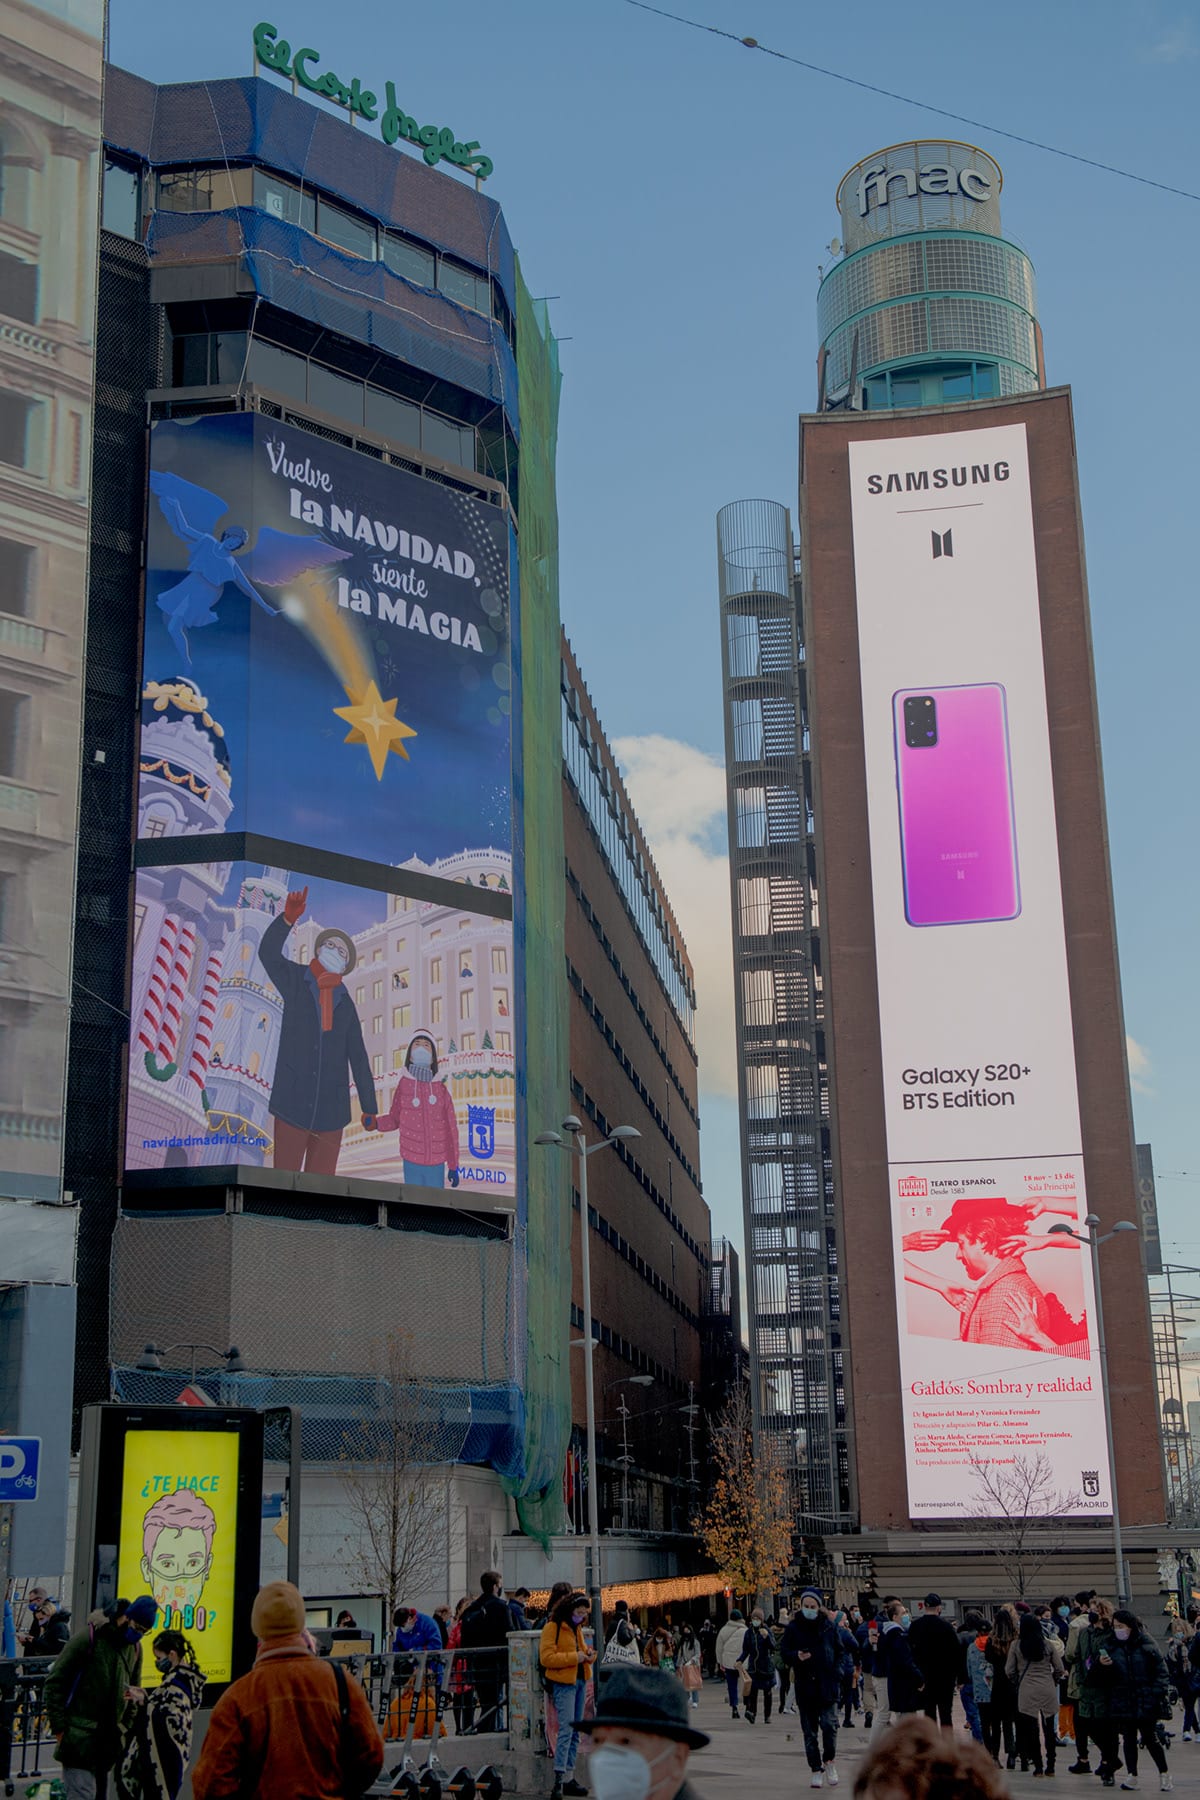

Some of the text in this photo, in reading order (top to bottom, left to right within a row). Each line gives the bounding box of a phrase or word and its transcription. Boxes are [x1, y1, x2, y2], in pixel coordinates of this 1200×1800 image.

[253, 22, 494, 178] El Corte Inglés
[856, 163, 992, 217] fnac
[266, 440, 333, 493] Vuelve
[867, 461, 1010, 495] SAMSUNG
[290, 488, 482, 588] la NAVIDAD,
[372, 558, 429, 598] siente
[338, 577, 483, 653] la MAGIA
[902, 1063, 1031, 1087] Galaxy S20+
[902, 1088, 1015, 1110] BTS Edition
[142, 1133, 266, 1149] navidadmadrid.com
[455, 1166, 507, 1184] MADRID
[961, 1177, 996, 1186] ESPAÑOL
[1027, 1181, 1076, 1192] Sala Principal
[911, 1376, 1093, 1398] Galdós: Sombra y realidad
[956, 1409, 975, 1417] Moral
[0, 1445, 26, 1478] P
[141, 1475, 220, 1498] ¿TE HACE
